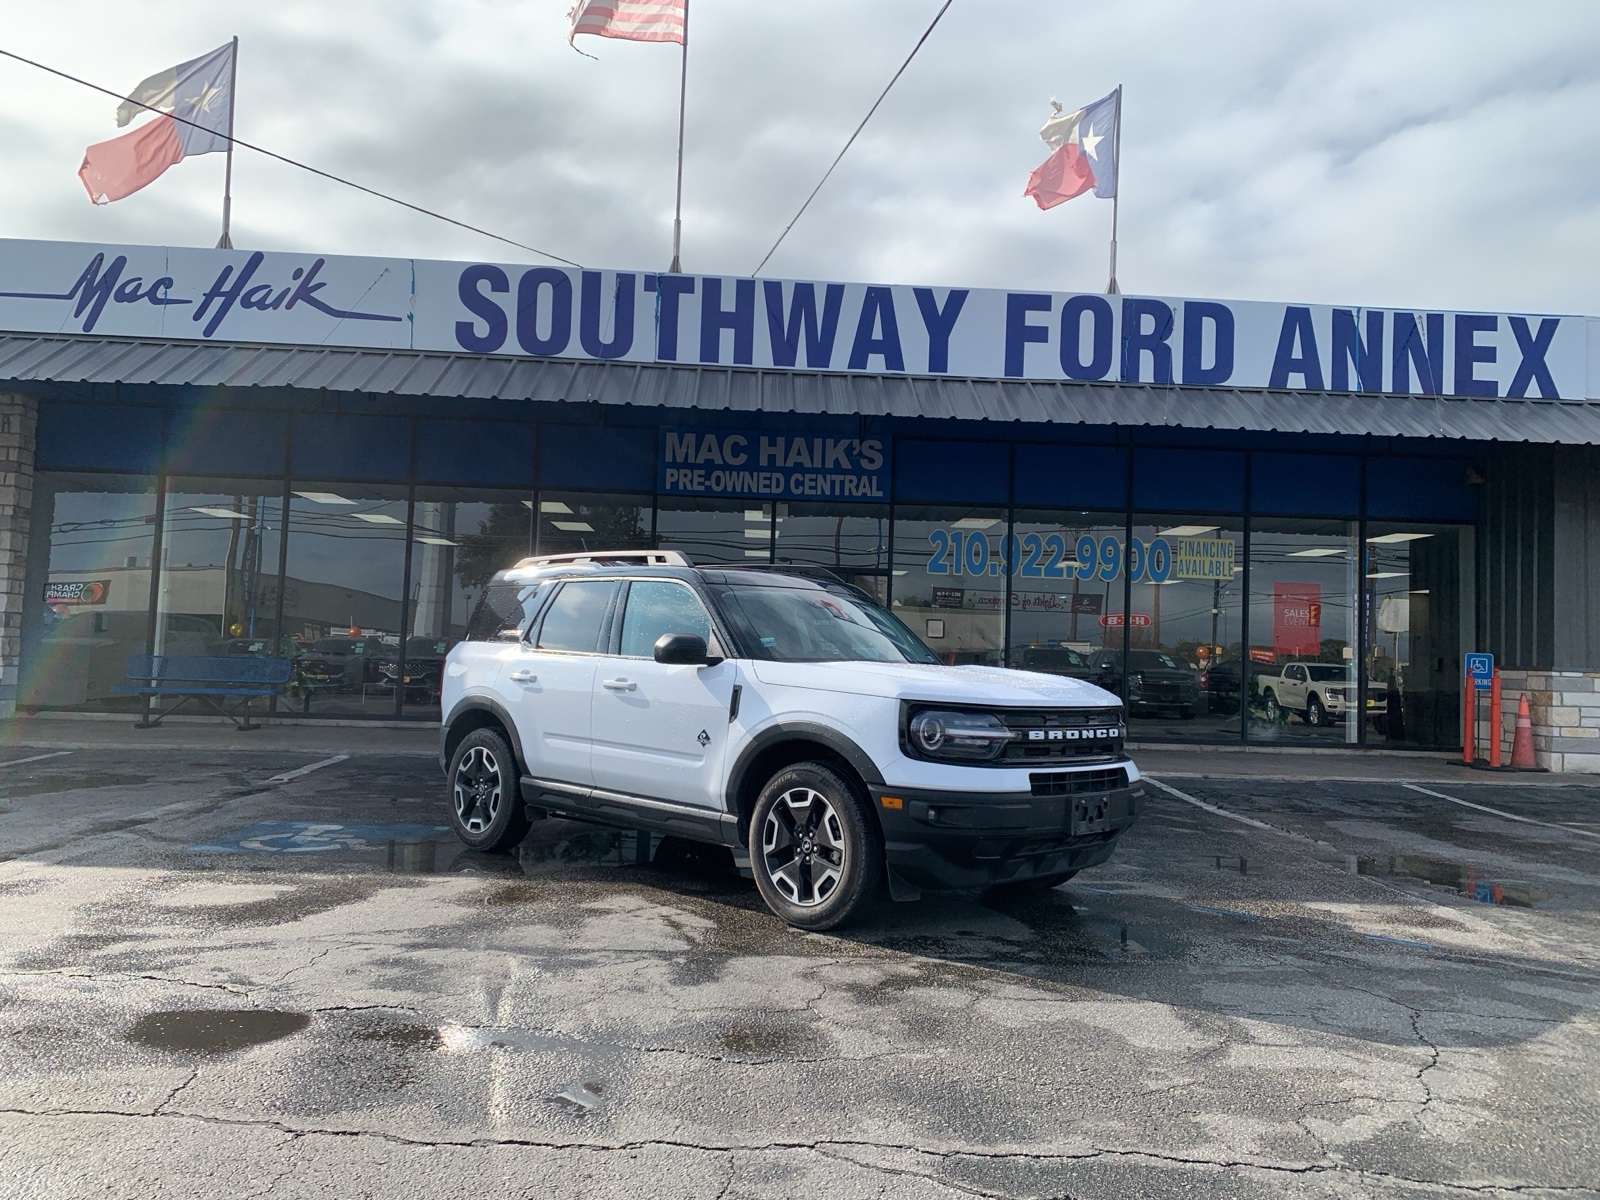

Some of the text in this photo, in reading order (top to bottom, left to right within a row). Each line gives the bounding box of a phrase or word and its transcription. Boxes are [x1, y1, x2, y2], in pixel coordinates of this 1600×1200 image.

[68, 250, 360, 338] Mac Haik
[455, 264, 1561, 399] SOUTHWAY FORD ANNEX
[665, 432, 884, 471] MAC HAIK'S
[665, 468, 884, 497] PRE-OWNED CENTRAL
[927, 529, 1172, 583] 210.922.9900
[1178, 540, 1233, 558] FINANCING
[1177, 557, 1234, 577] AVAILABLE
[1284, 609, 1310, 617] SALES
[1284, 617, 1310, 626] EVENT
[1474, 678, 1492, 686] RKING
[1029, 728, 1119, 740] BRONCO
